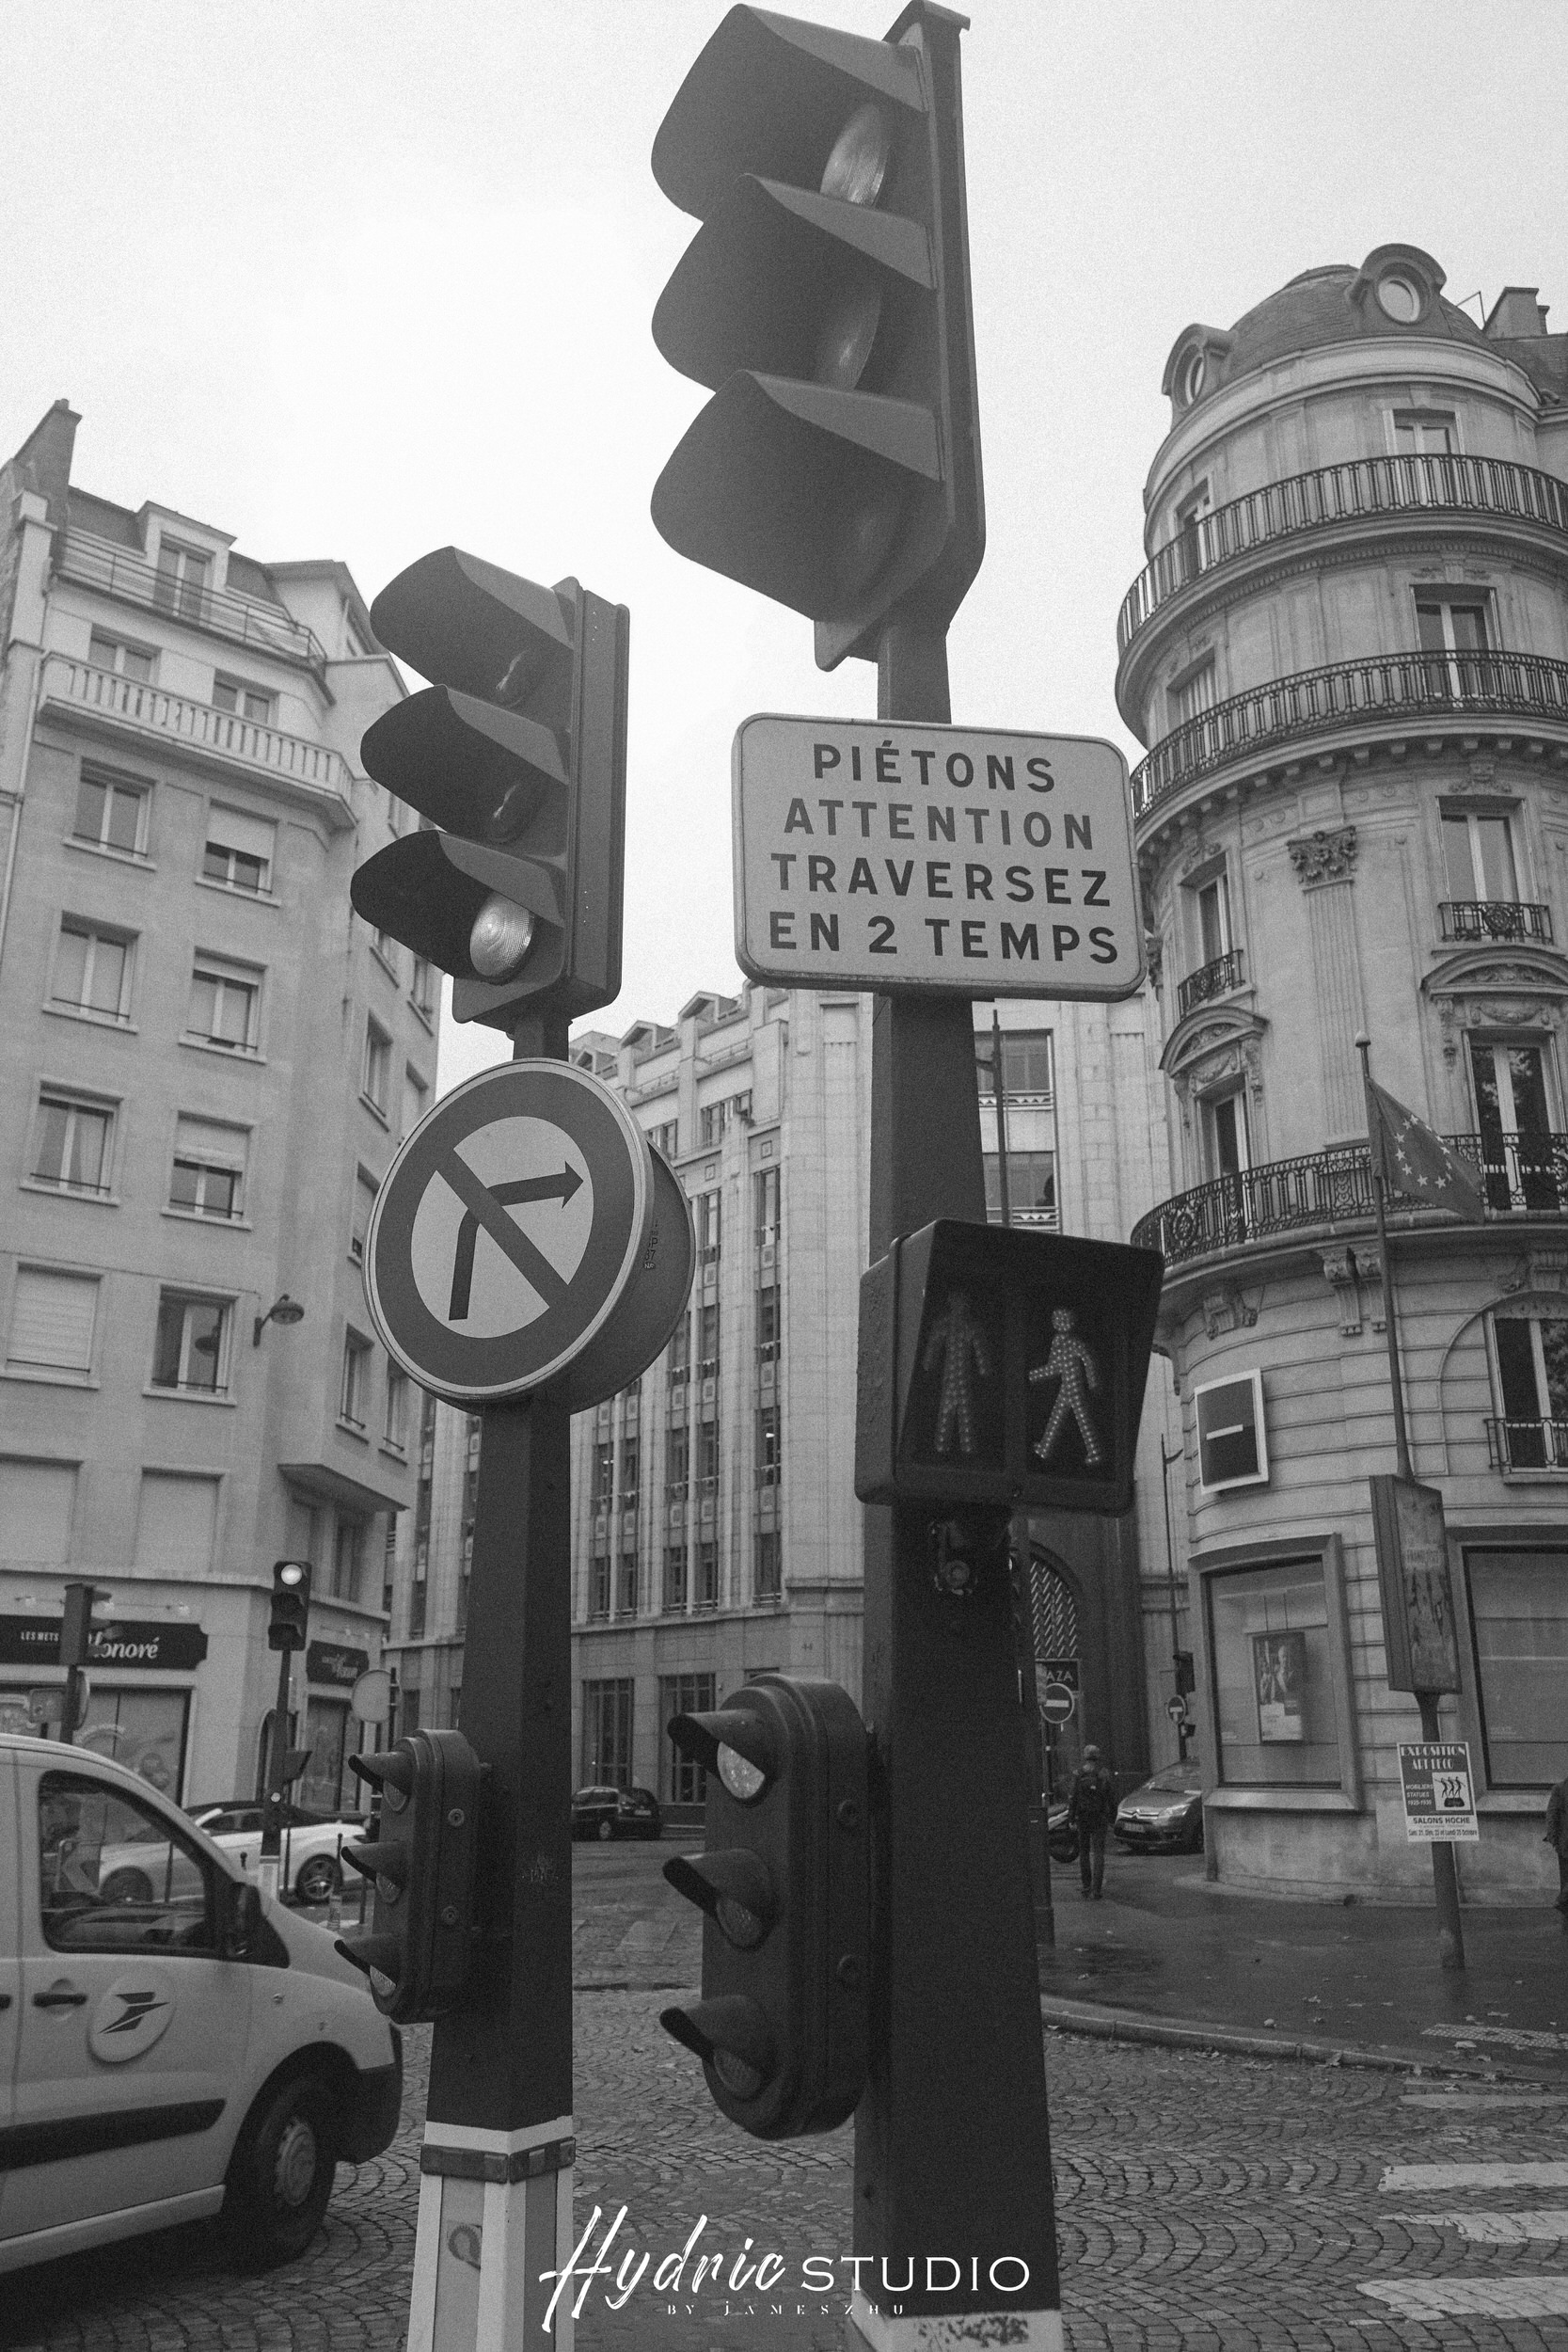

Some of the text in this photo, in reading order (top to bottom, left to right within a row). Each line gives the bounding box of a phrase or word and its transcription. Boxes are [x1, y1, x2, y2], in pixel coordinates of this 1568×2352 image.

[813, 739, 1055, 793] PIÉTONS
[784, 798, 1093, 850] ATTENTION
[770, 852, 1111, 907] TRAVERSEZ
[769, 911, 1118, 964] EN 2 TEMPS
[21, 1630, 60, 1642] LES METS
[1046, 1670, 1074, 1682] AZA
[1401, 1745, 1465, 1756] EXPOSITION
